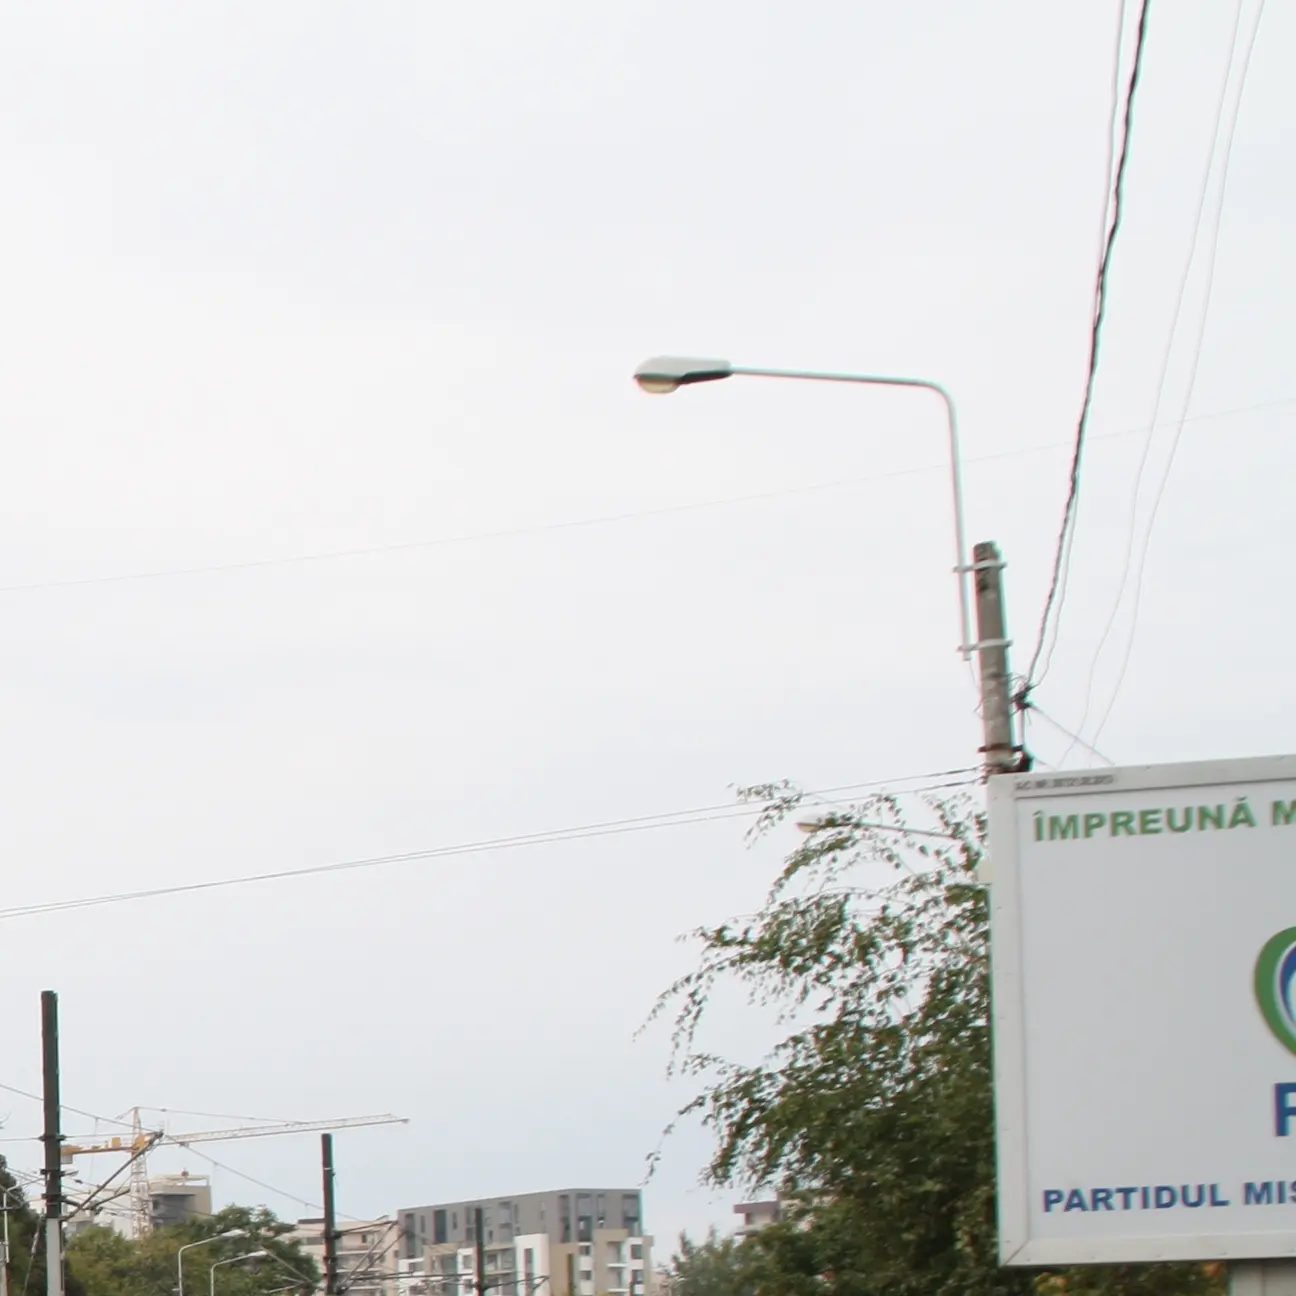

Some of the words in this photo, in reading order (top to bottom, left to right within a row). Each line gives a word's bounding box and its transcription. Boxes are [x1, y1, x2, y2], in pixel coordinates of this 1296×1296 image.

[1033, 796, 1256, 841] ÎMPREUNĂ
[1043, 1183, 1231, 1212] PARTIDUL
[1242, 1181, 1296, 1206] MI
